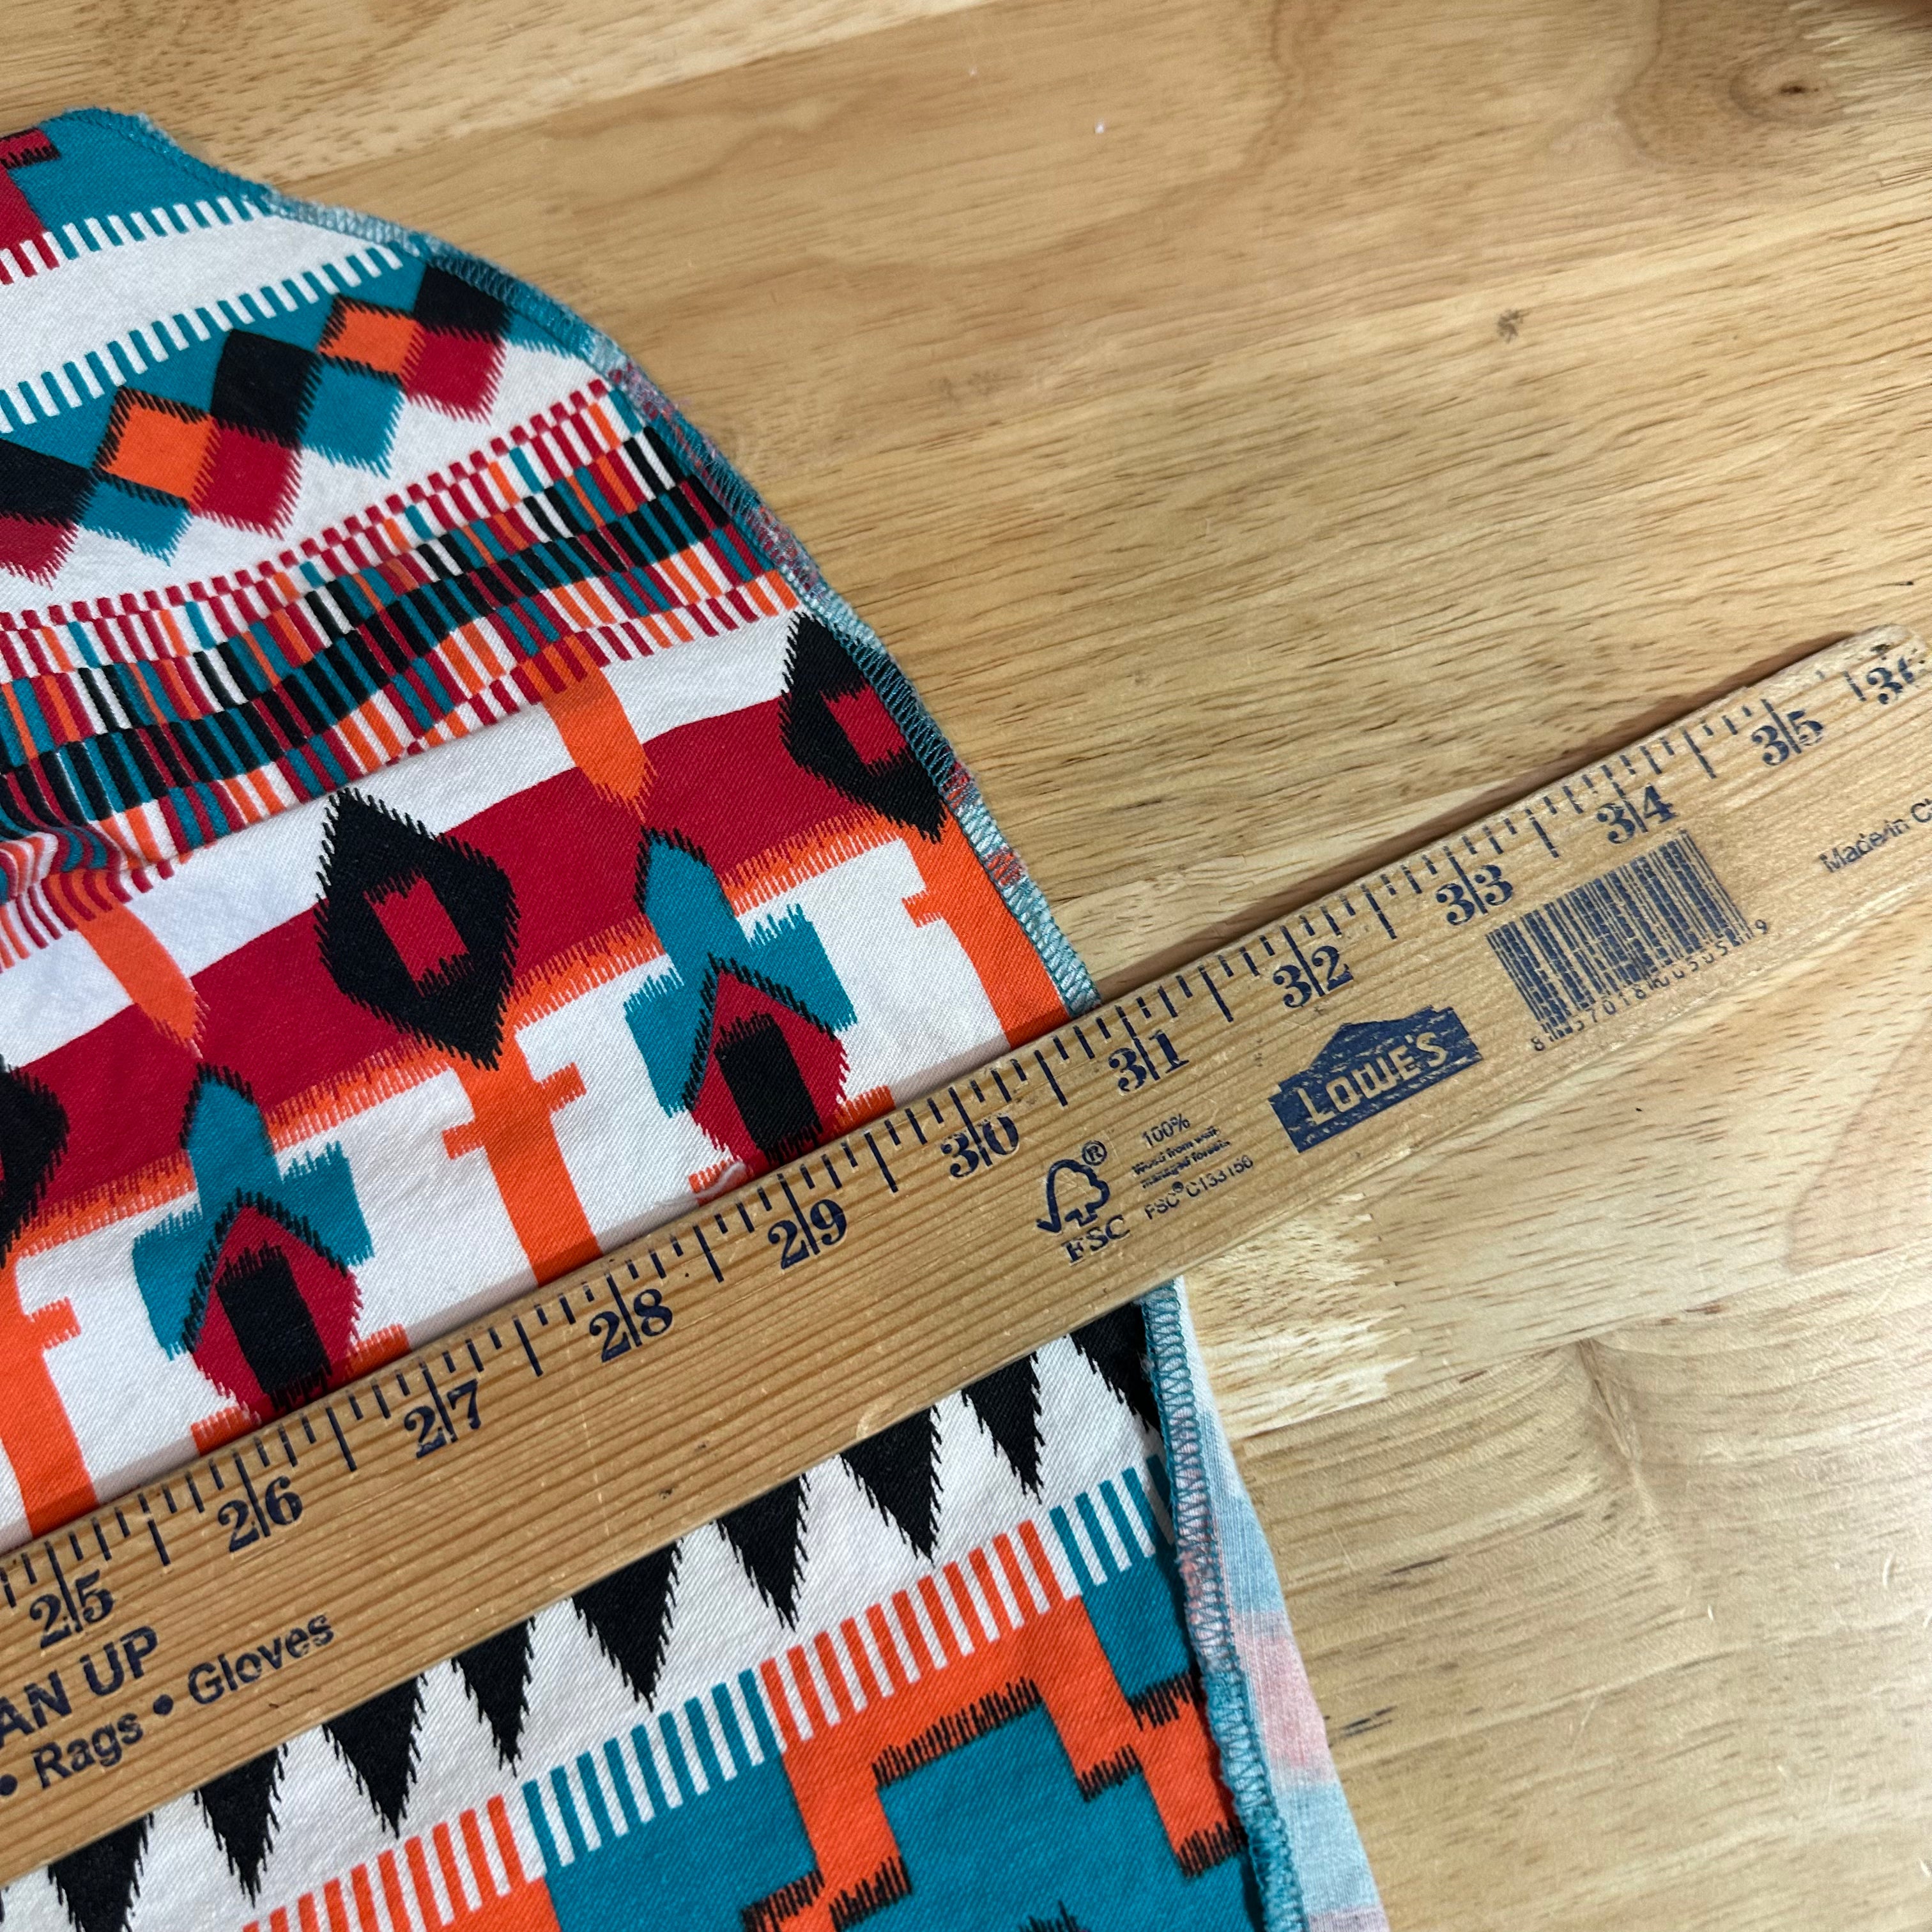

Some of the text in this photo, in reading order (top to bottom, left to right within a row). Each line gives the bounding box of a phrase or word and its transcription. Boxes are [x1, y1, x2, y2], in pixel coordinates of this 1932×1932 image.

[1751, 709, 1824, 766] 35
[1597, 785, 1678, 844] 34
[1818, 832, 1889, 873] Made
[1435, 863, 1514, 926] 33
[1273, 944, 1354, 1009] 32
[1108, 1029, 1189, 1092] 31
[1297, 1031, 1448, 1126] LOWE'S
[942, 1116, 1020, 1179] 30
[1142, 1113, 1191, 1148] 100%
[767, 1198, 848, 1270] 29
[1061, 1214, 1131, 1263] FSC
[588, 1287, 673, 1363] 28
[403, 1378, 481, 1459] 27
[217, 1476, 304, 1553] 26
[29, 1568, 115, 1649] 25
[79, 1625, 158, 1697] UP
[32, 1613, 335, 1790] Rags Gloves
